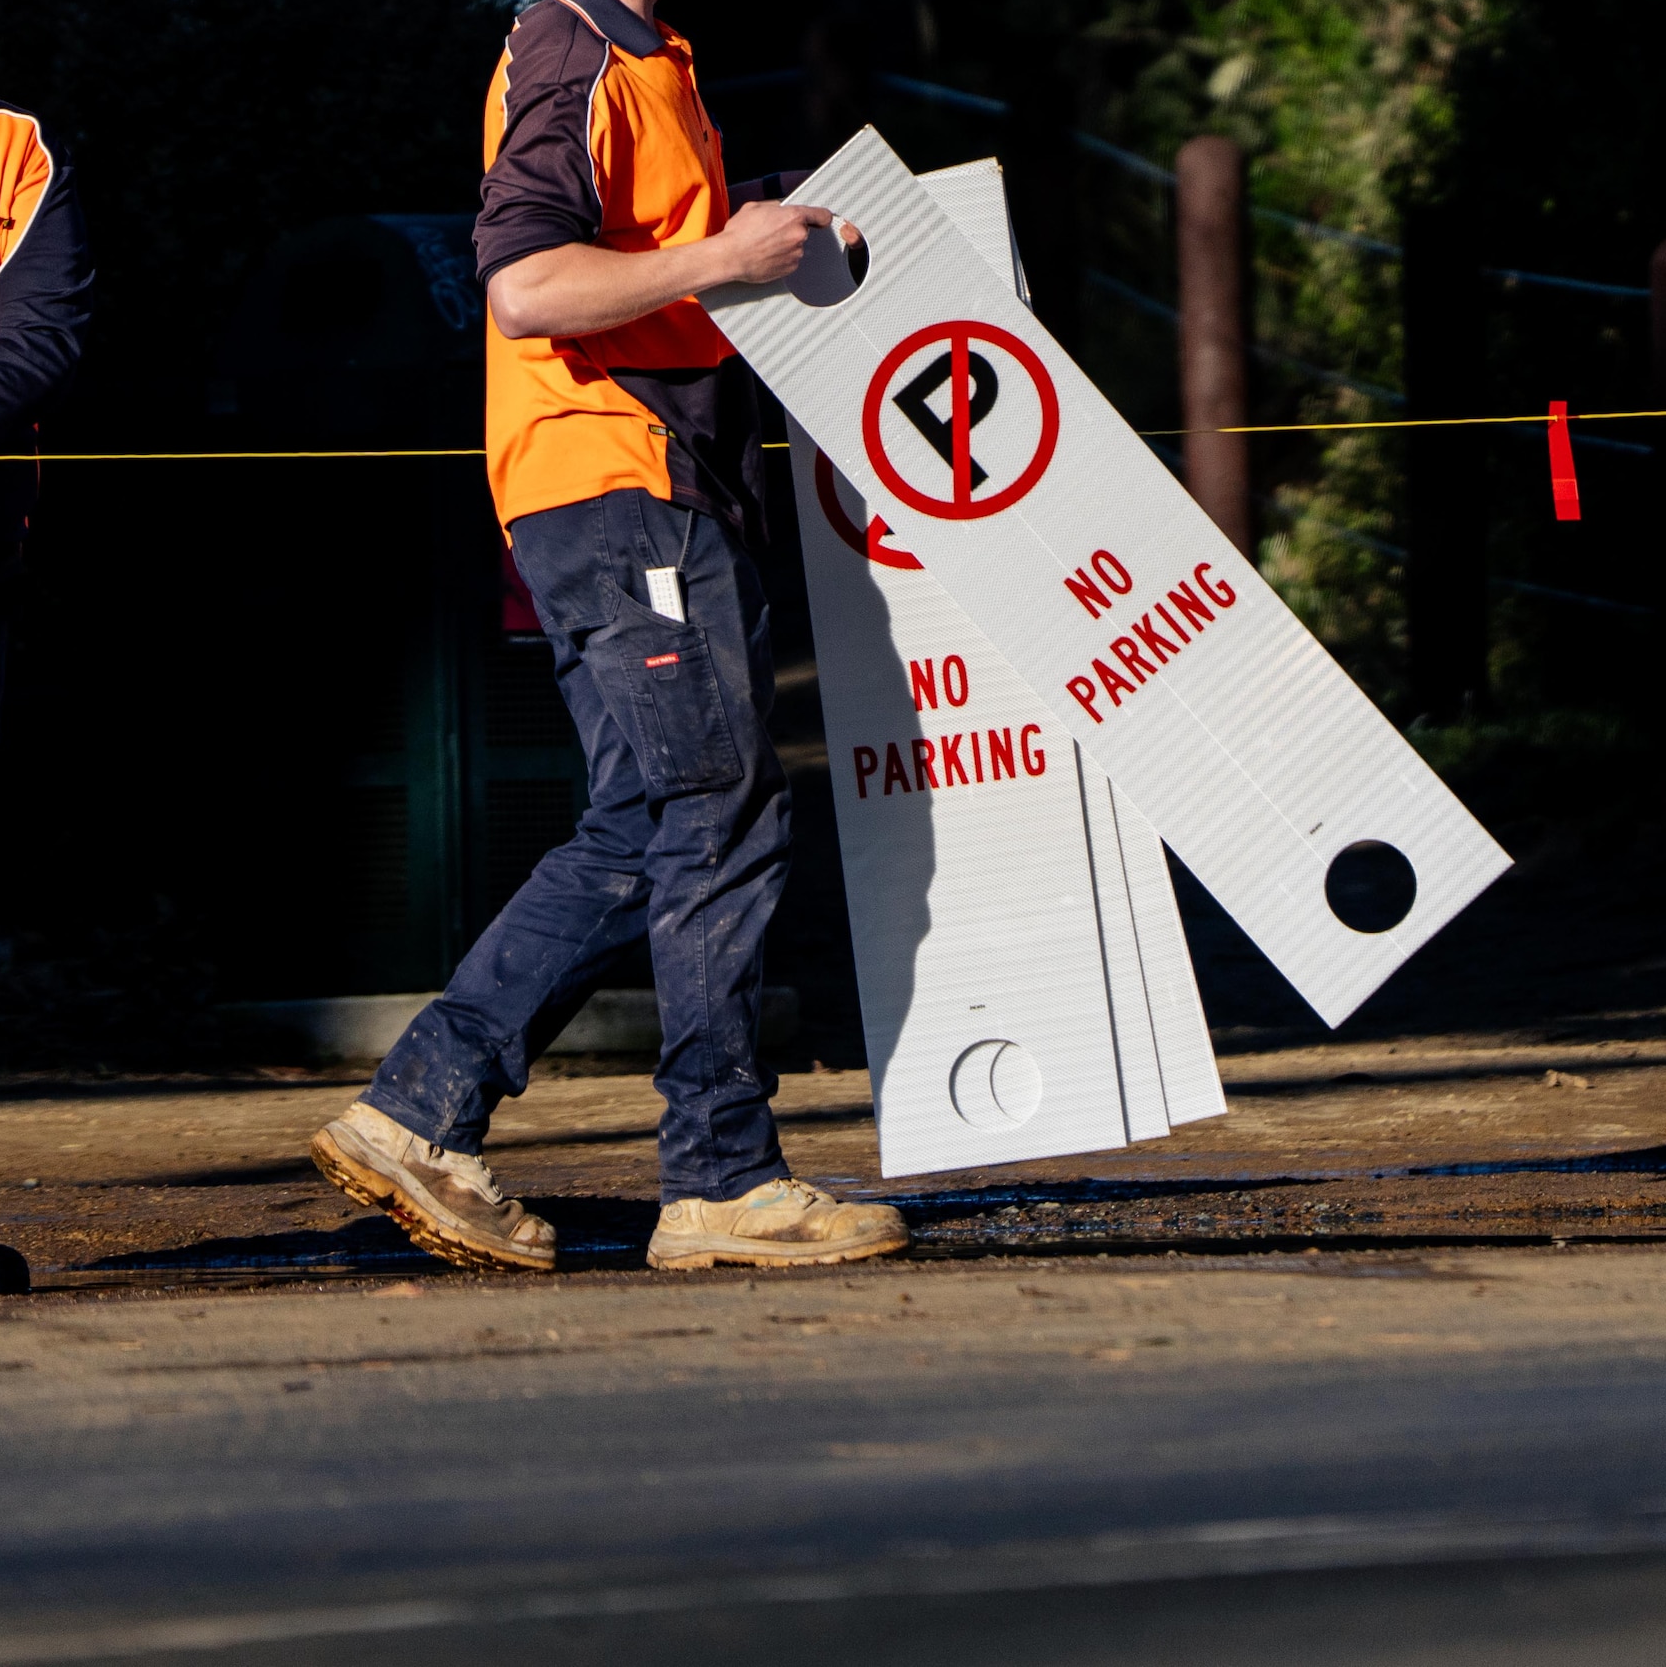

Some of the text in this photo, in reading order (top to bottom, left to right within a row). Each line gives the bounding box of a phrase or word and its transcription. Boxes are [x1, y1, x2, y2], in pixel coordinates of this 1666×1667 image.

[1063, 549, 1134, 620] NO
[1065, 562, 1237, 725] PARKING
[909, 654, 969, 712] NO
[852, 724, 1046, 800] PARKING
